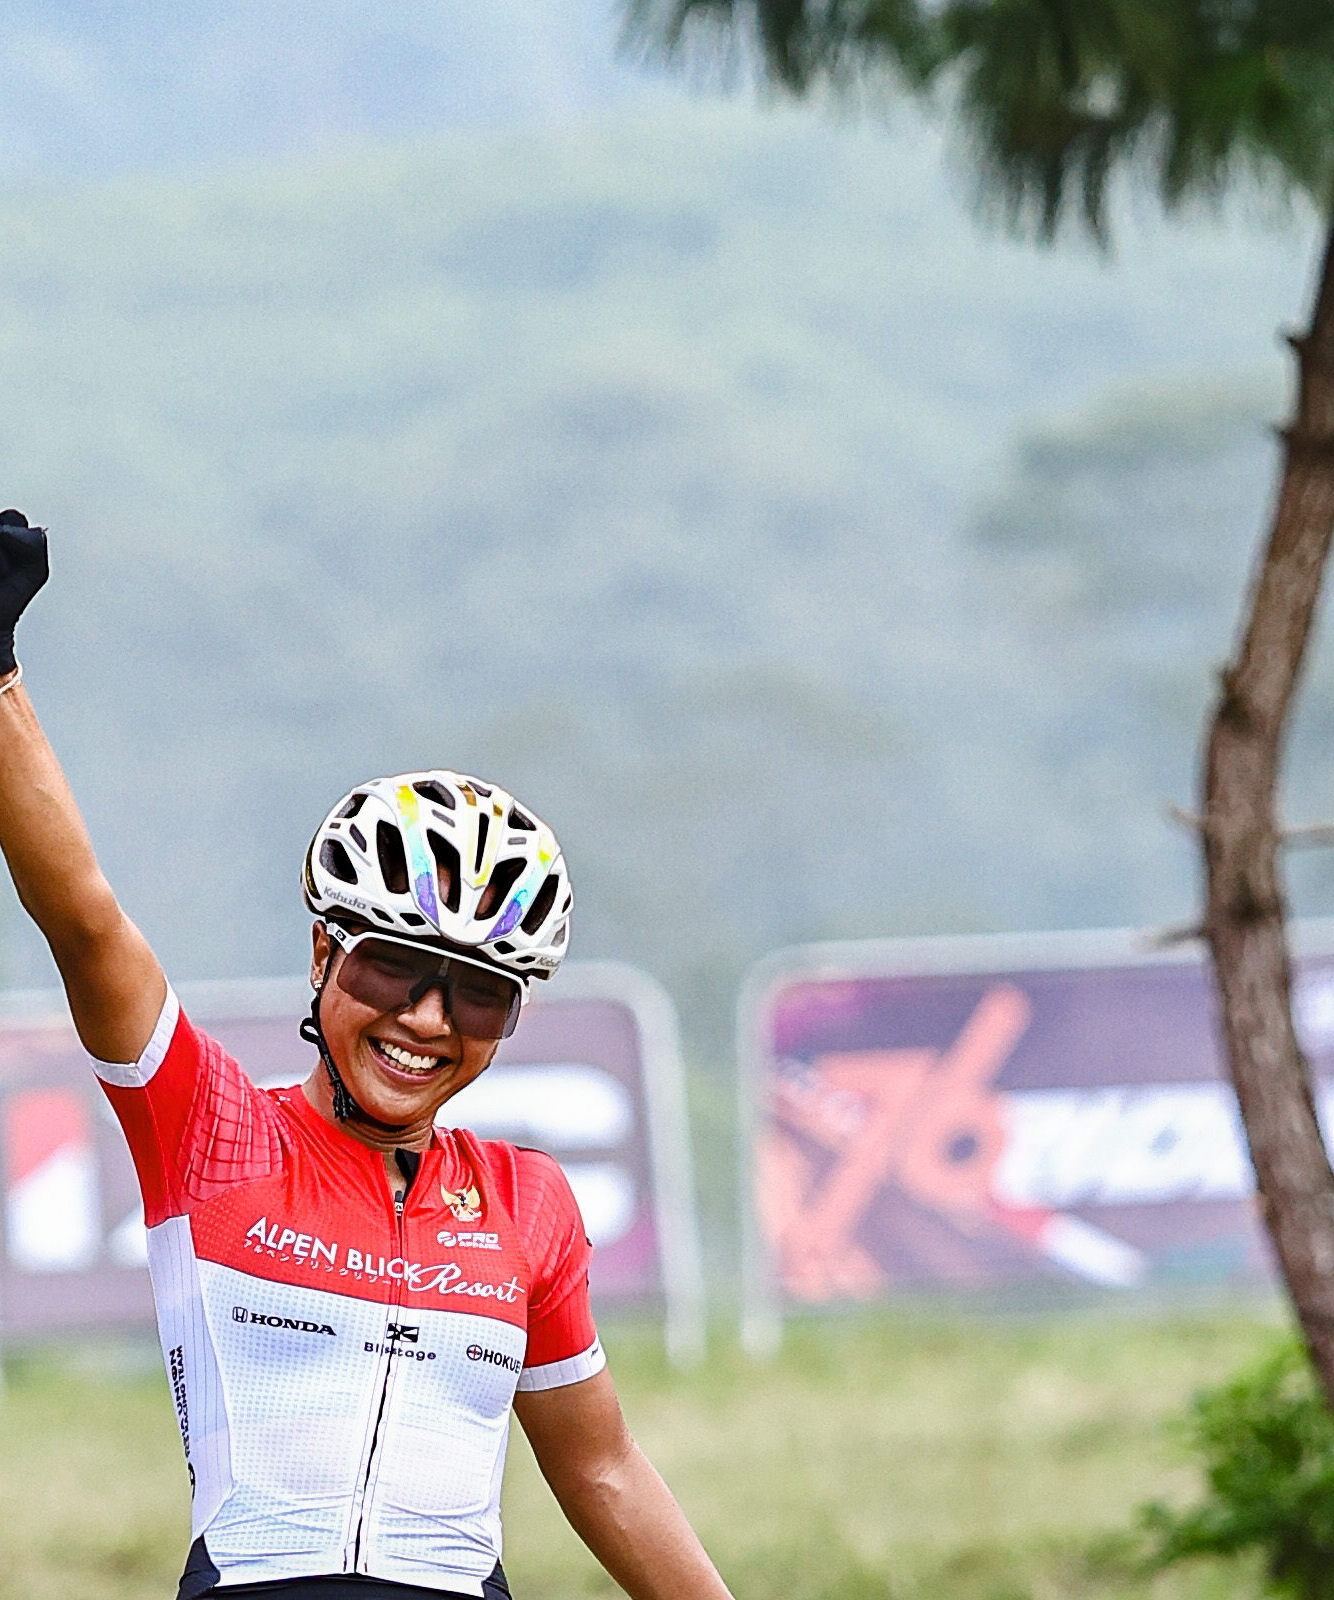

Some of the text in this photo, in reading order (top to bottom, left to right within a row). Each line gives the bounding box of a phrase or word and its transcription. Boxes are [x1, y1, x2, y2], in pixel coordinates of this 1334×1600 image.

[323, 886, 367, 910] Kabuto
[456, 1232, 499, 1244] PRO
[246, 1216, 526, 1303] ALPEN BLICK Resort
[250, 1313, 337, 1337] HONDA
[364, 1342, 437, 1361] Blisstage
